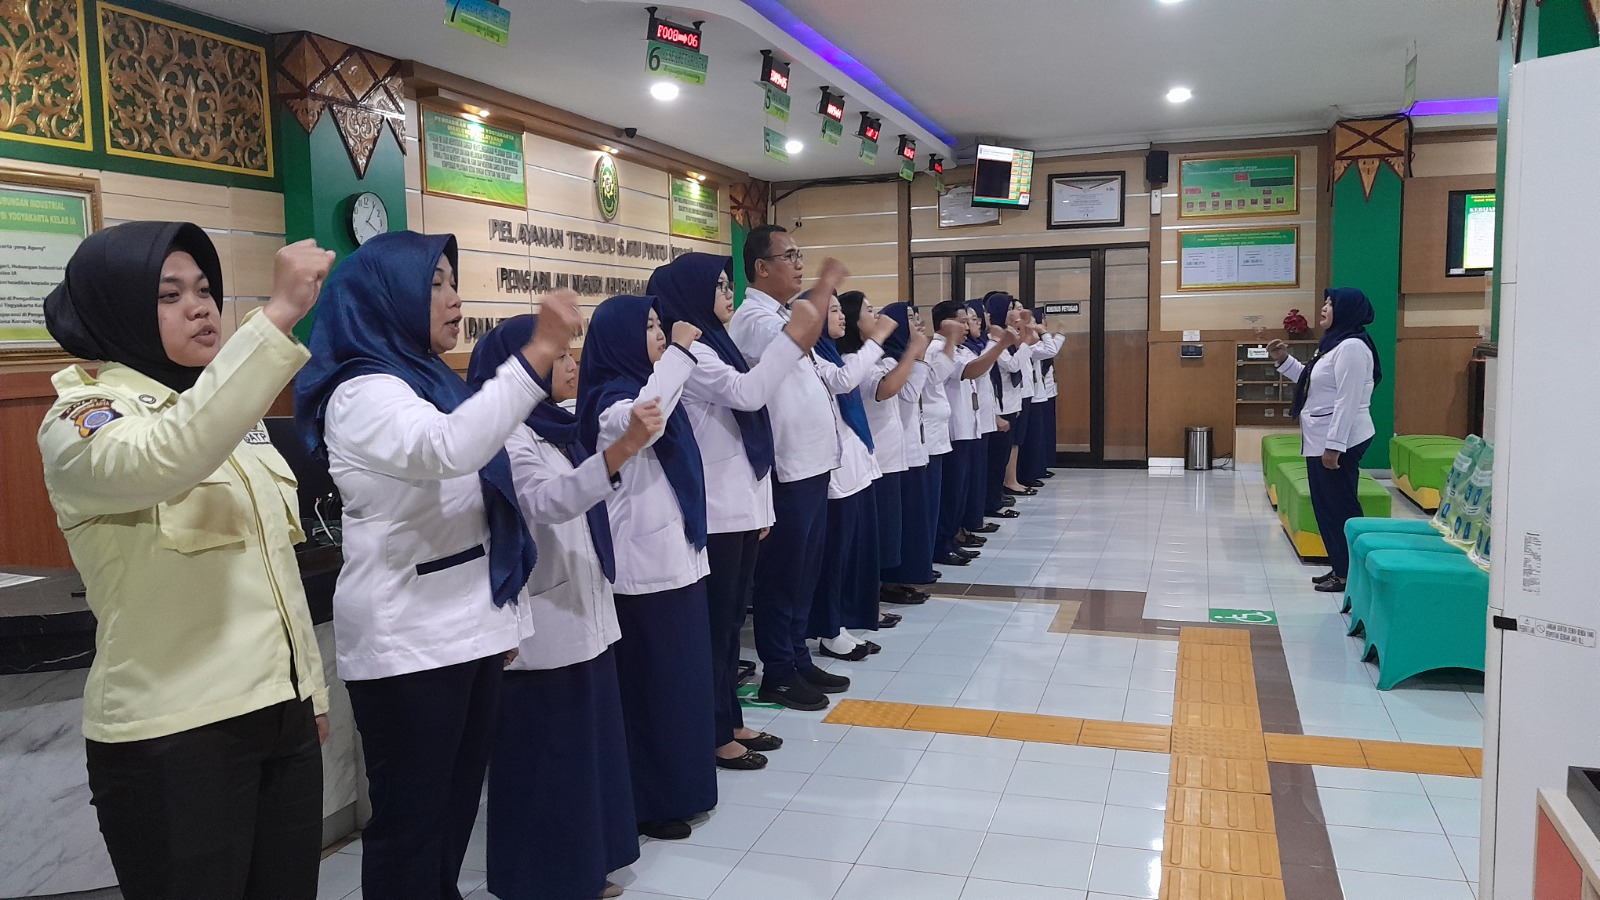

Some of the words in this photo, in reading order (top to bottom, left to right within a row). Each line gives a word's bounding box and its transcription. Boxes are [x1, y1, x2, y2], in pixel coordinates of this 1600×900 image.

[687, 33, 698, 47] 06
[649, 46, 661, 72] 6
[765, 88, 771, 109] 5
[489, 219, 563, 249] PELAYANAN
